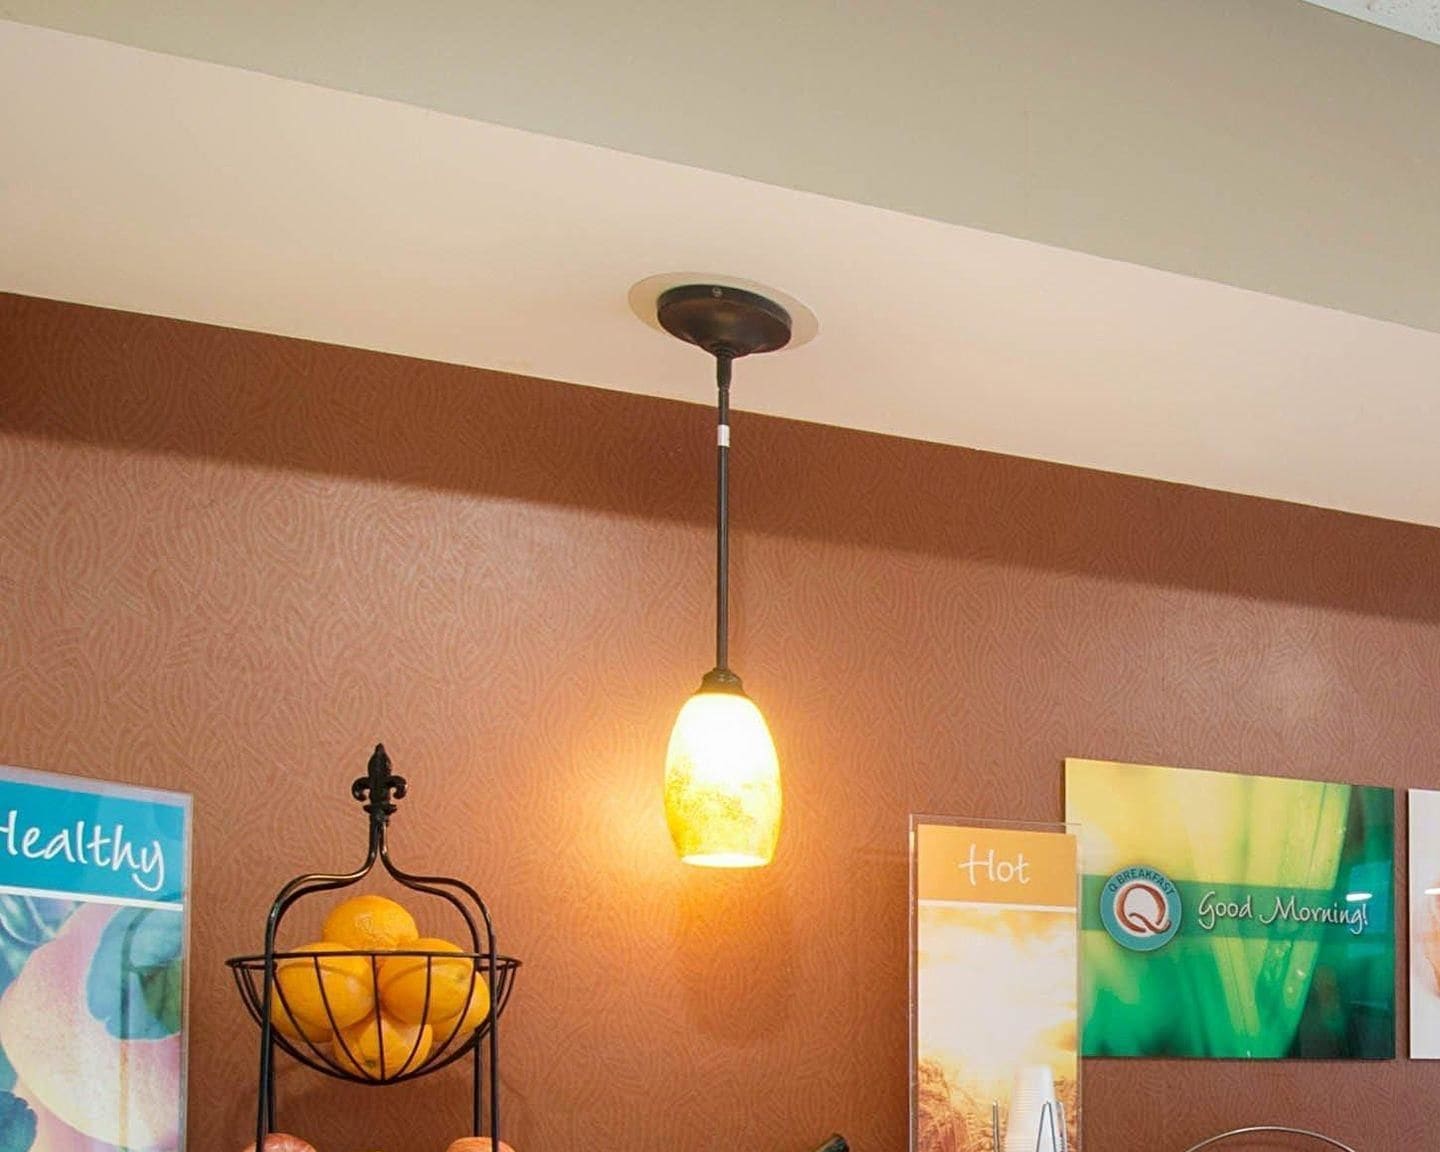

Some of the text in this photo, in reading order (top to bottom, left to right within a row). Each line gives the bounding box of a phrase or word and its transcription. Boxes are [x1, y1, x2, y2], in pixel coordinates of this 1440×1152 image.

[958, 843, 1031, 887] Hot
[1117, 868, 1175, 896] BREAKFAST
[1116, 883, 1172, 934] Q
[1198, 890, 1368, 935] Good Morning!
